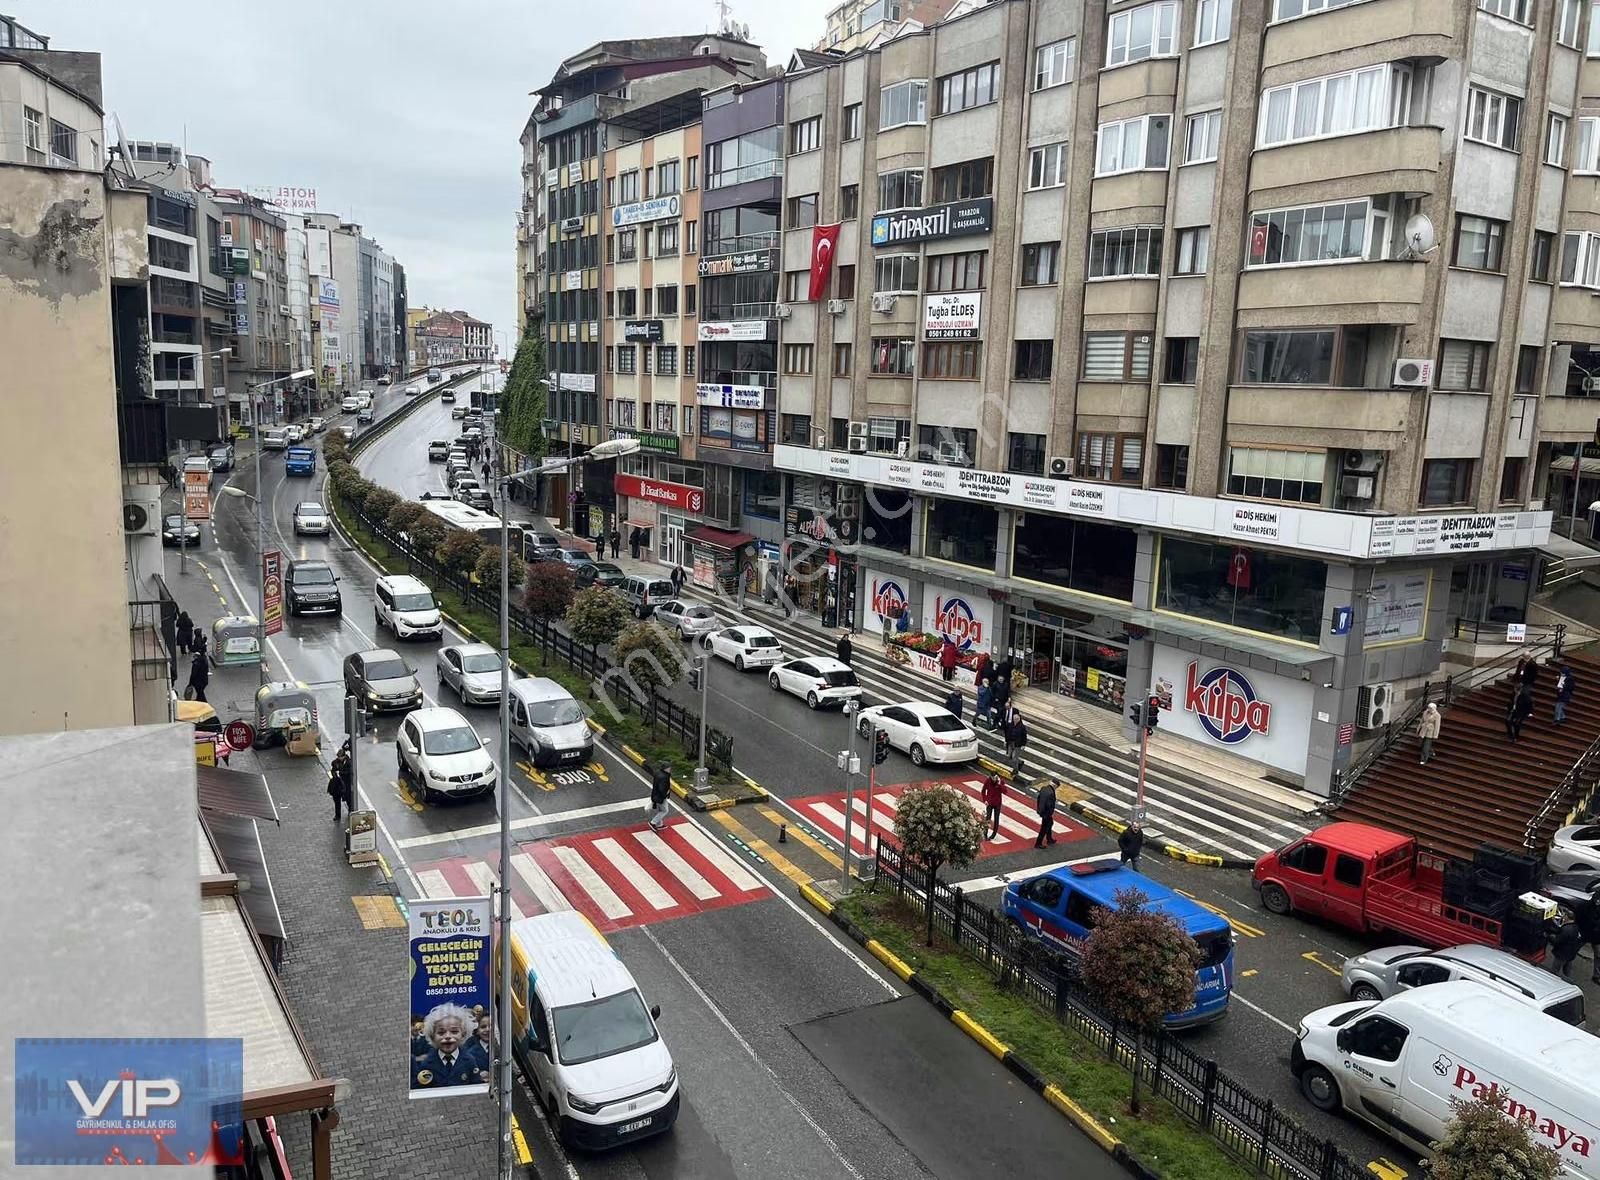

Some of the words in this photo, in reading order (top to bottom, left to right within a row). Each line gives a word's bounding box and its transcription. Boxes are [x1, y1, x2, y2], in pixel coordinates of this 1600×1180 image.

[958, 207, 980, 217] TRABZON
[928, 306, 949, 320] Tuğba
[950, 304, 975, 319] ELDEŞ
[1243, 509, 1254, 521] DİŞ
[1254, 511, 1277, 523] HEKİMİ
[934, 595, 982, 648] kilpa
[918, 655, 937, 672] TAZE
[1184, 659, 1272, 740] kilpa
[552, 770, 595, 785] önce
[420, 909, 480, 928] TEOL
[423, 926, 458, 934] ANAOKULU
[465, 925, 481, 933] KREŞ
[418, 939, 483, 953] GELECEĞİN
[422, 950, 479, 964] DAHİLERİ
[426, 962, 475, 975] TEOL'DE
[429, 974, 473, 987] BÜYÜR
[426, 988, 443, 996] 0850
